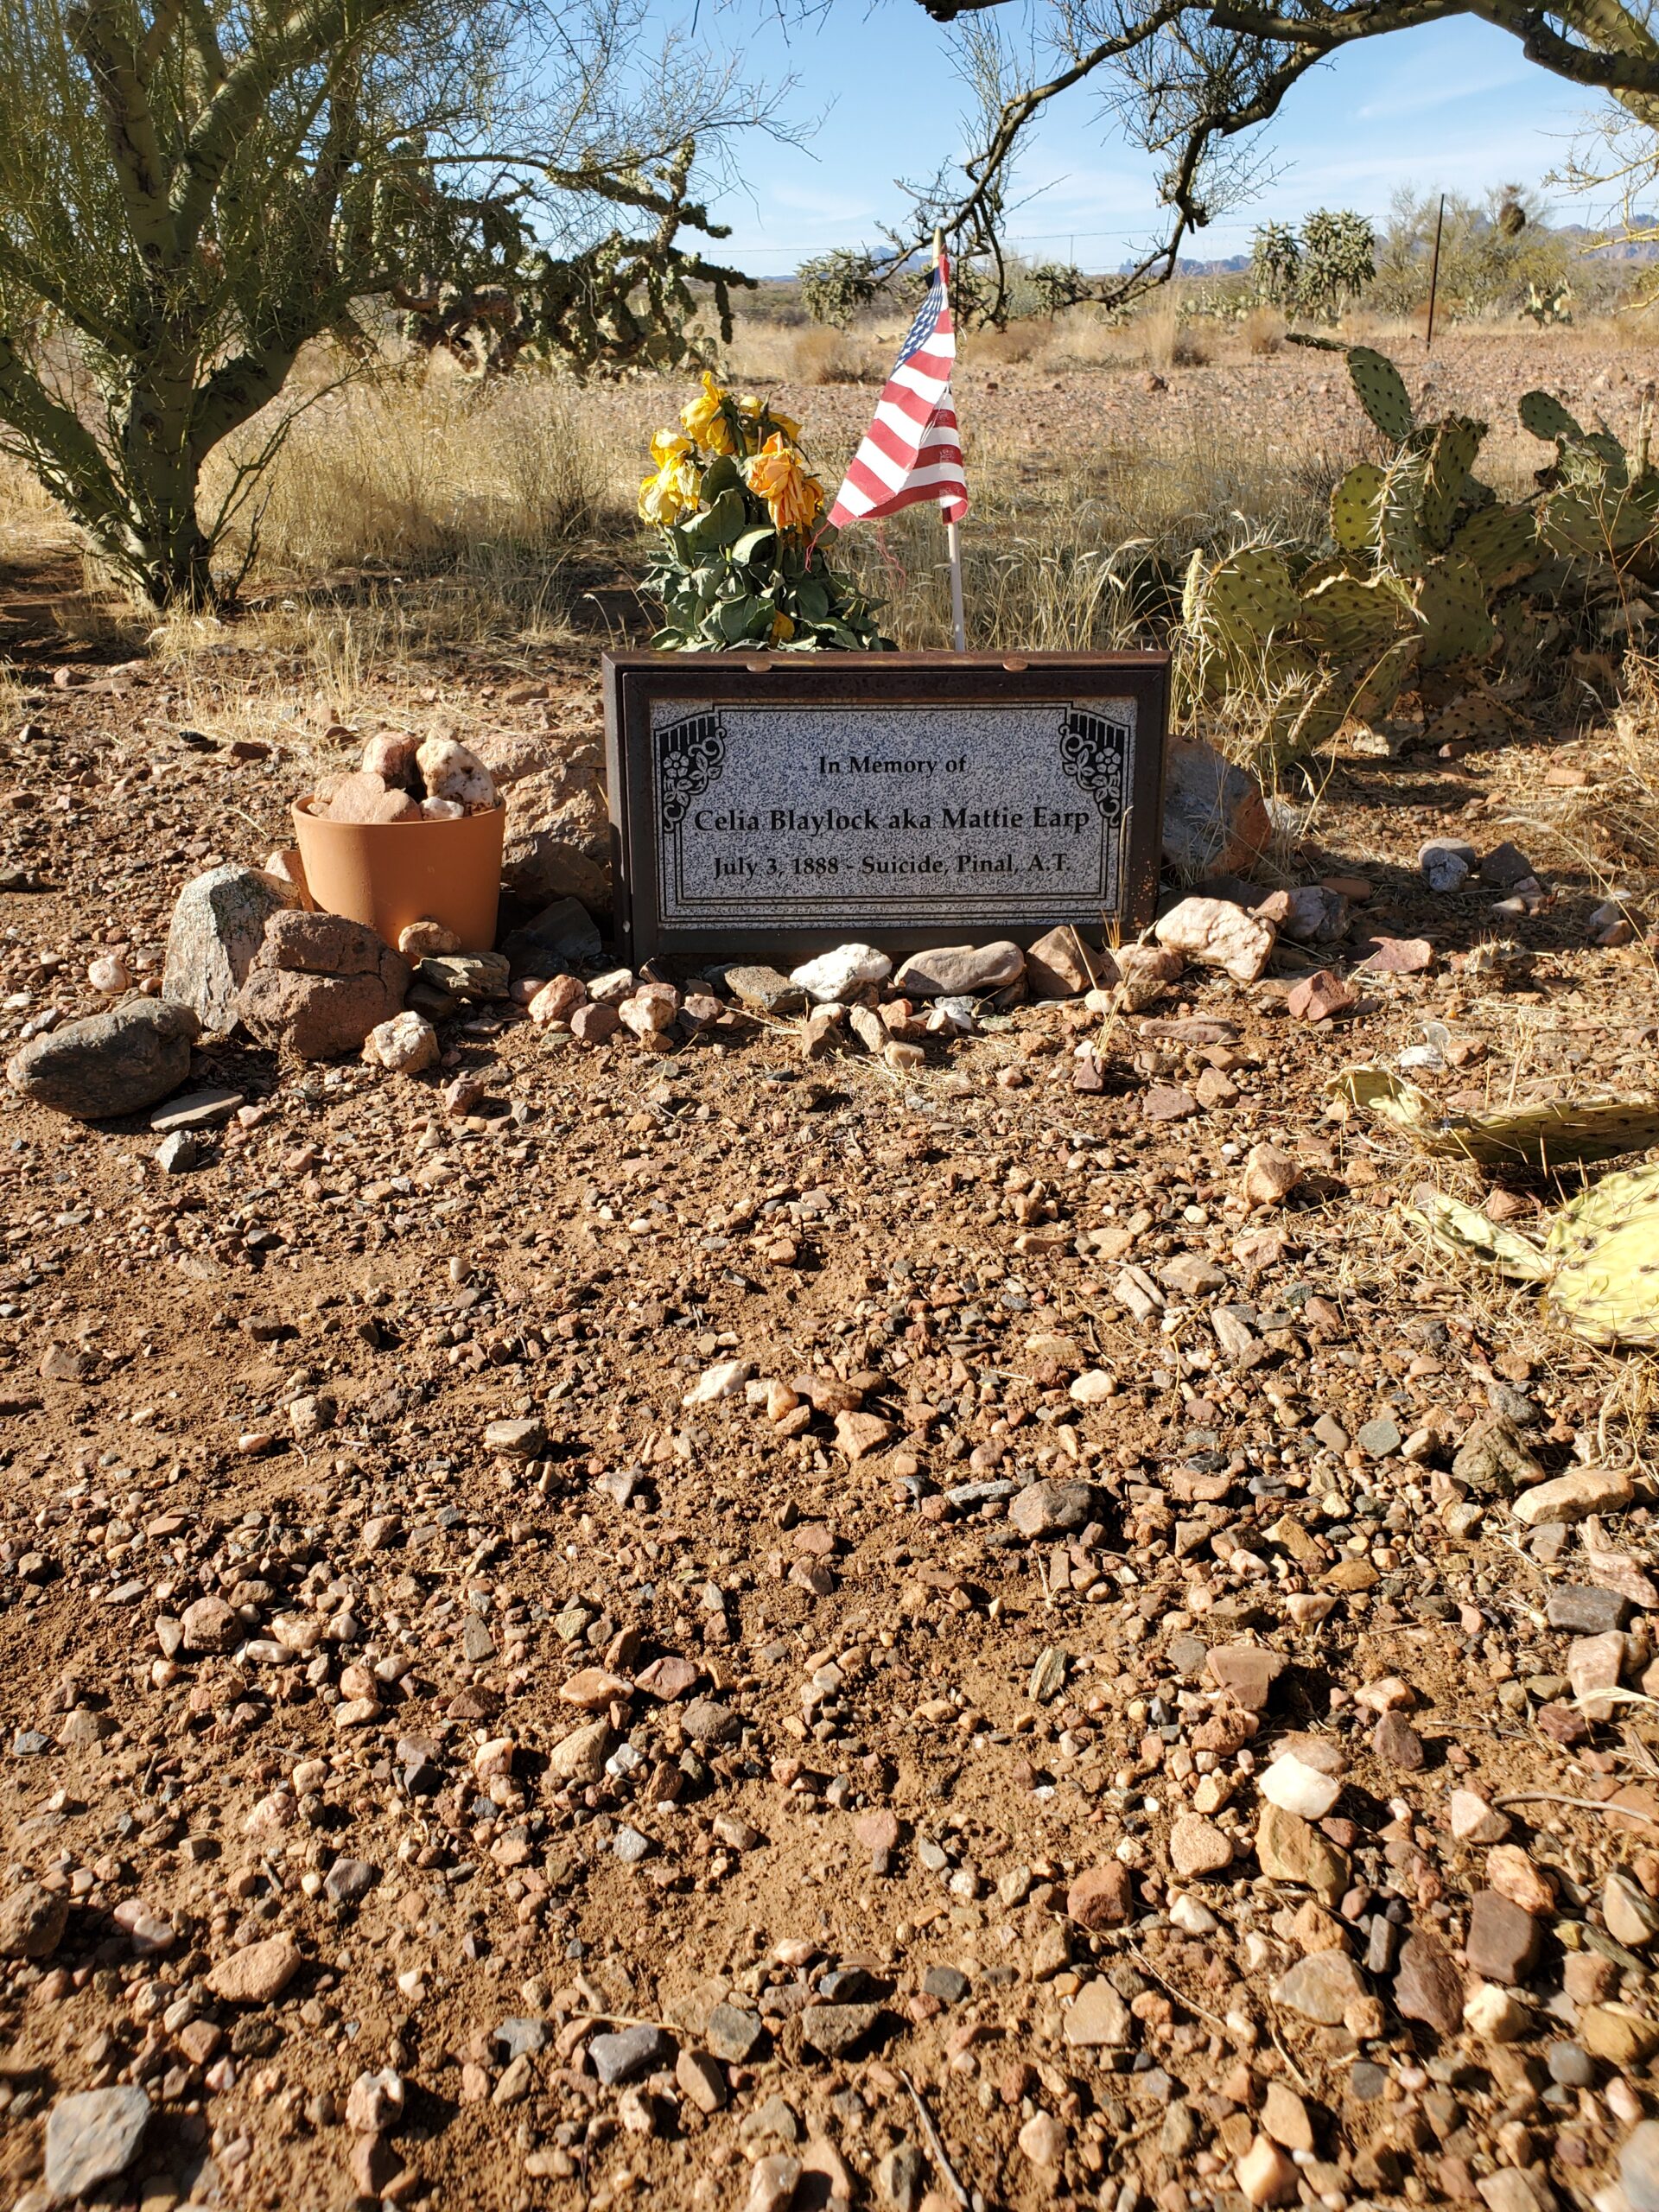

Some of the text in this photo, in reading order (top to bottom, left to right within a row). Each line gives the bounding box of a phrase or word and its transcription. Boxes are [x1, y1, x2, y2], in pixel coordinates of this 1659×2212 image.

[820, 754, 966, 777] In Memory of
[695, 806, 1089, 836] Celia Blaylock aka Mattie Earp
[714, 857, 758, 879] July
[766, 857, 784, 878] 3,
[792, 857, 838, 874] 1888
[862, 855, 950, 875] Suicide,
[957, 854, 1018, 874] Pinal,
[1027, 853, 1071, 872] A.T.
